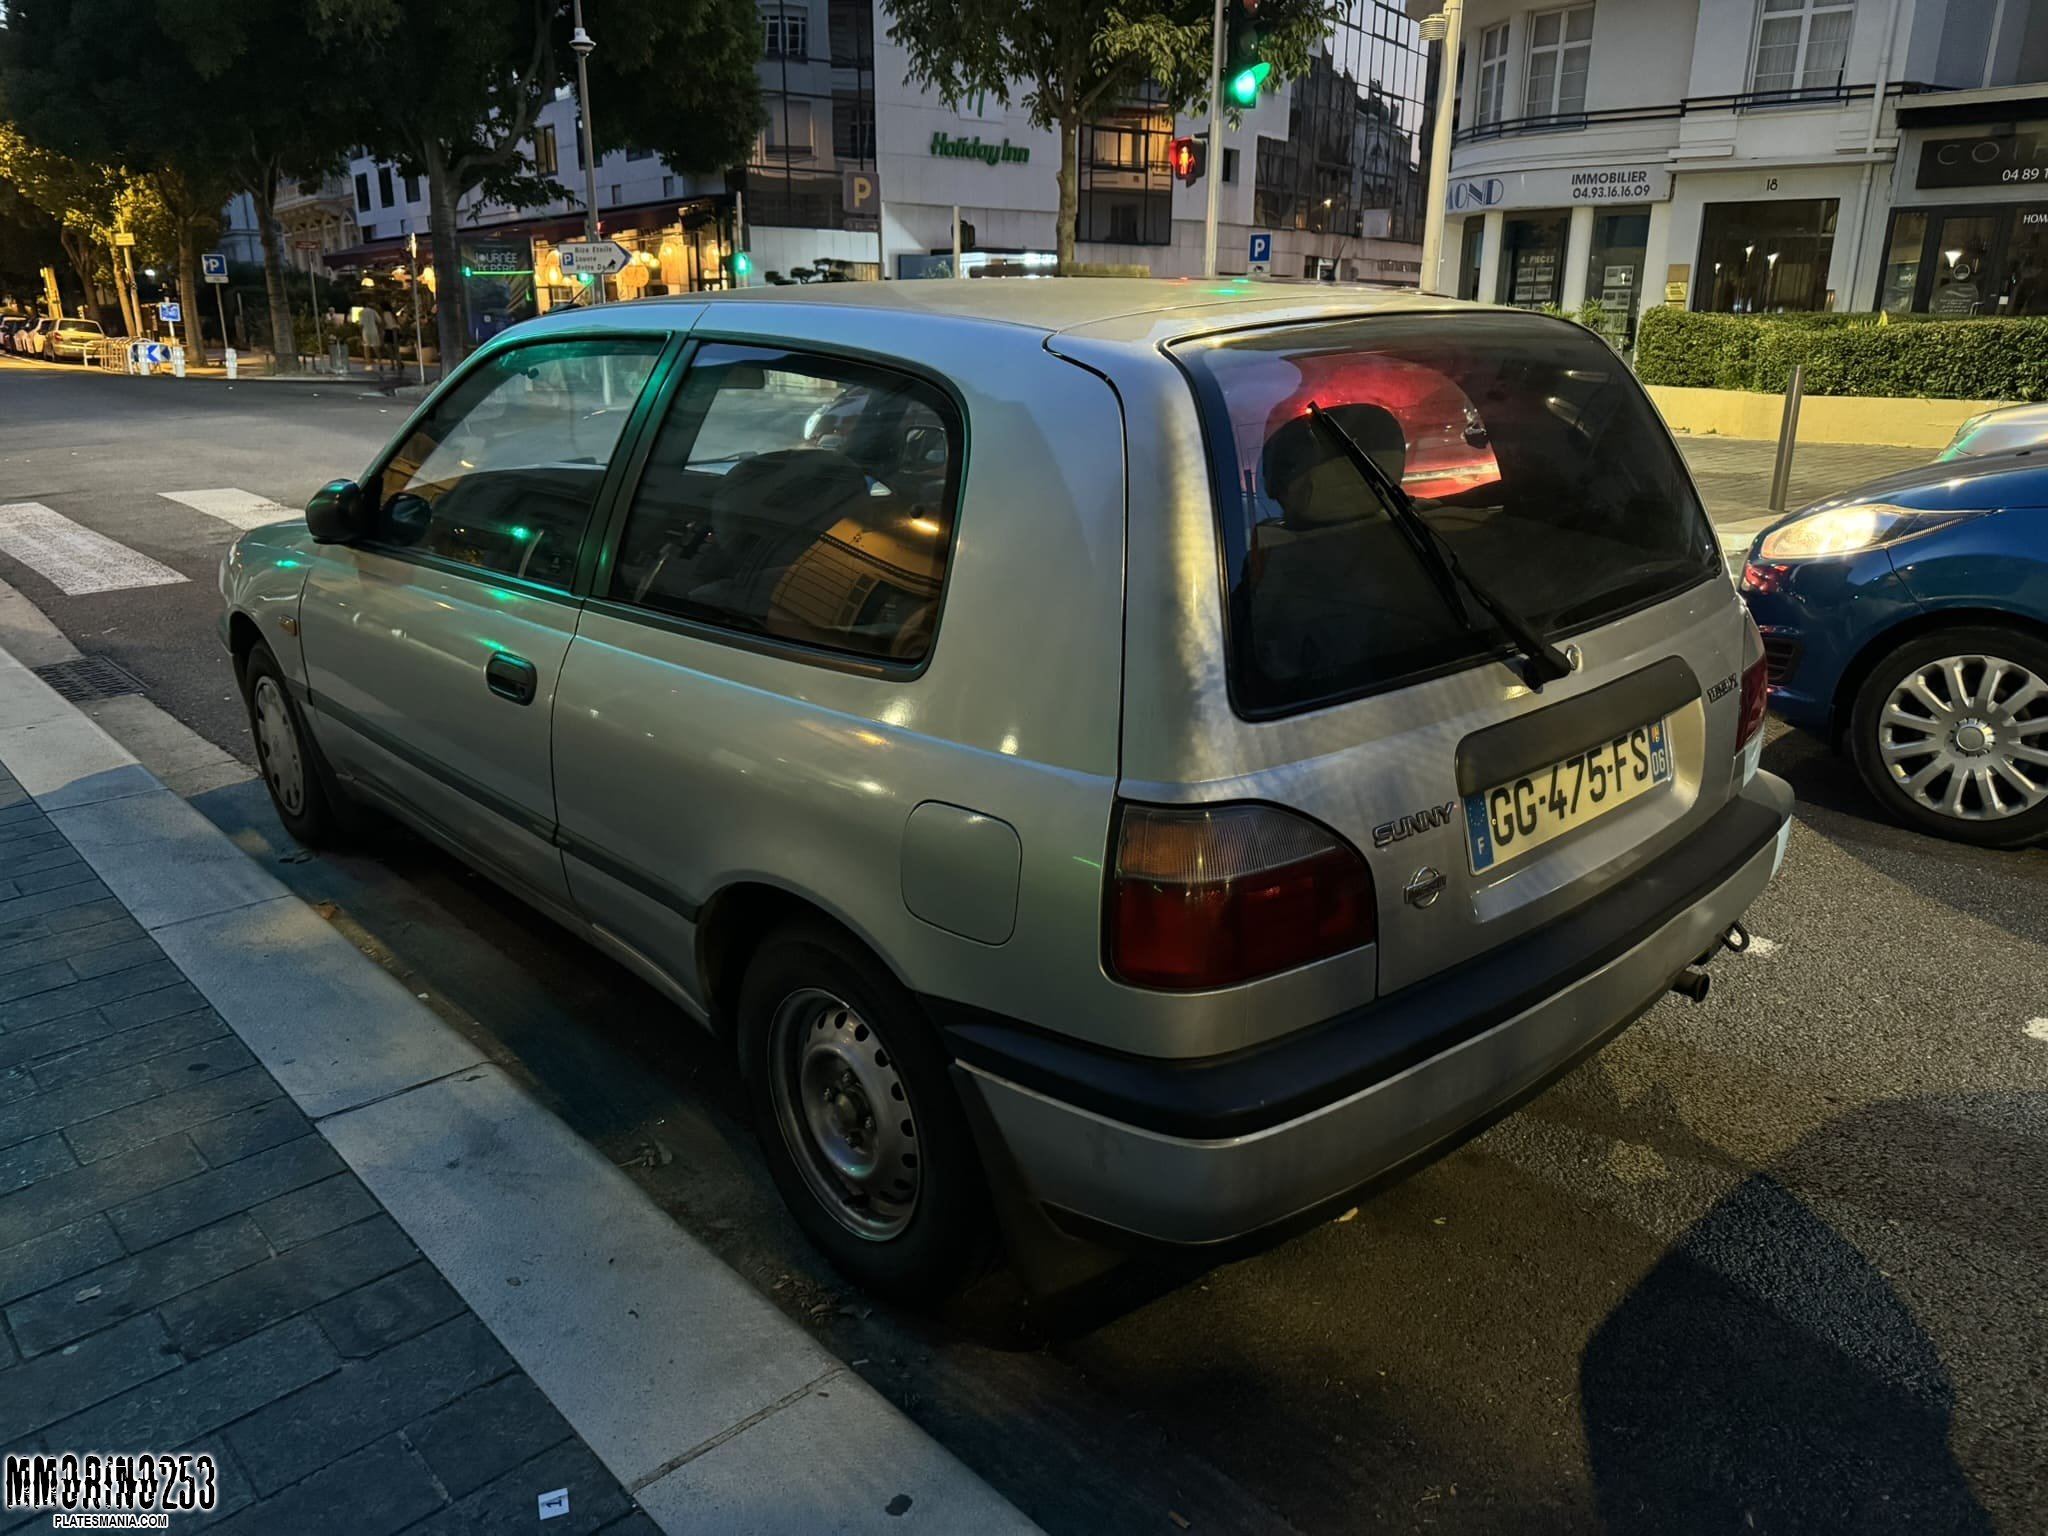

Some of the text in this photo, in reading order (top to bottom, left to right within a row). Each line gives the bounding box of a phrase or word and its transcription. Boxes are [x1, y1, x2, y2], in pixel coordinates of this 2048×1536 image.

[930, 131, 1030, 166] Holiday Inn
[1571, 170, 1647, 185] IMMOBILIER
[2002, 169, 2019, 181] 04
[2021, 168, 2040, 180] 89
[854, 176, 872, 208] P
[1572, 184, 1651, 198] 04.93.16.16.09
[1766, 178, 1778, 191] 18
[1254, 238, 1265, 257] P
[209, 258, 220, 272] P
[564, 254, 572, 265] P
[1651, 749, 1666, 777] 06
[1490, 728, 1649, 846] GG-475-FS
[1372, 801, 1454, 848] SUNNY
[1477, 836, 1485, 856] F
